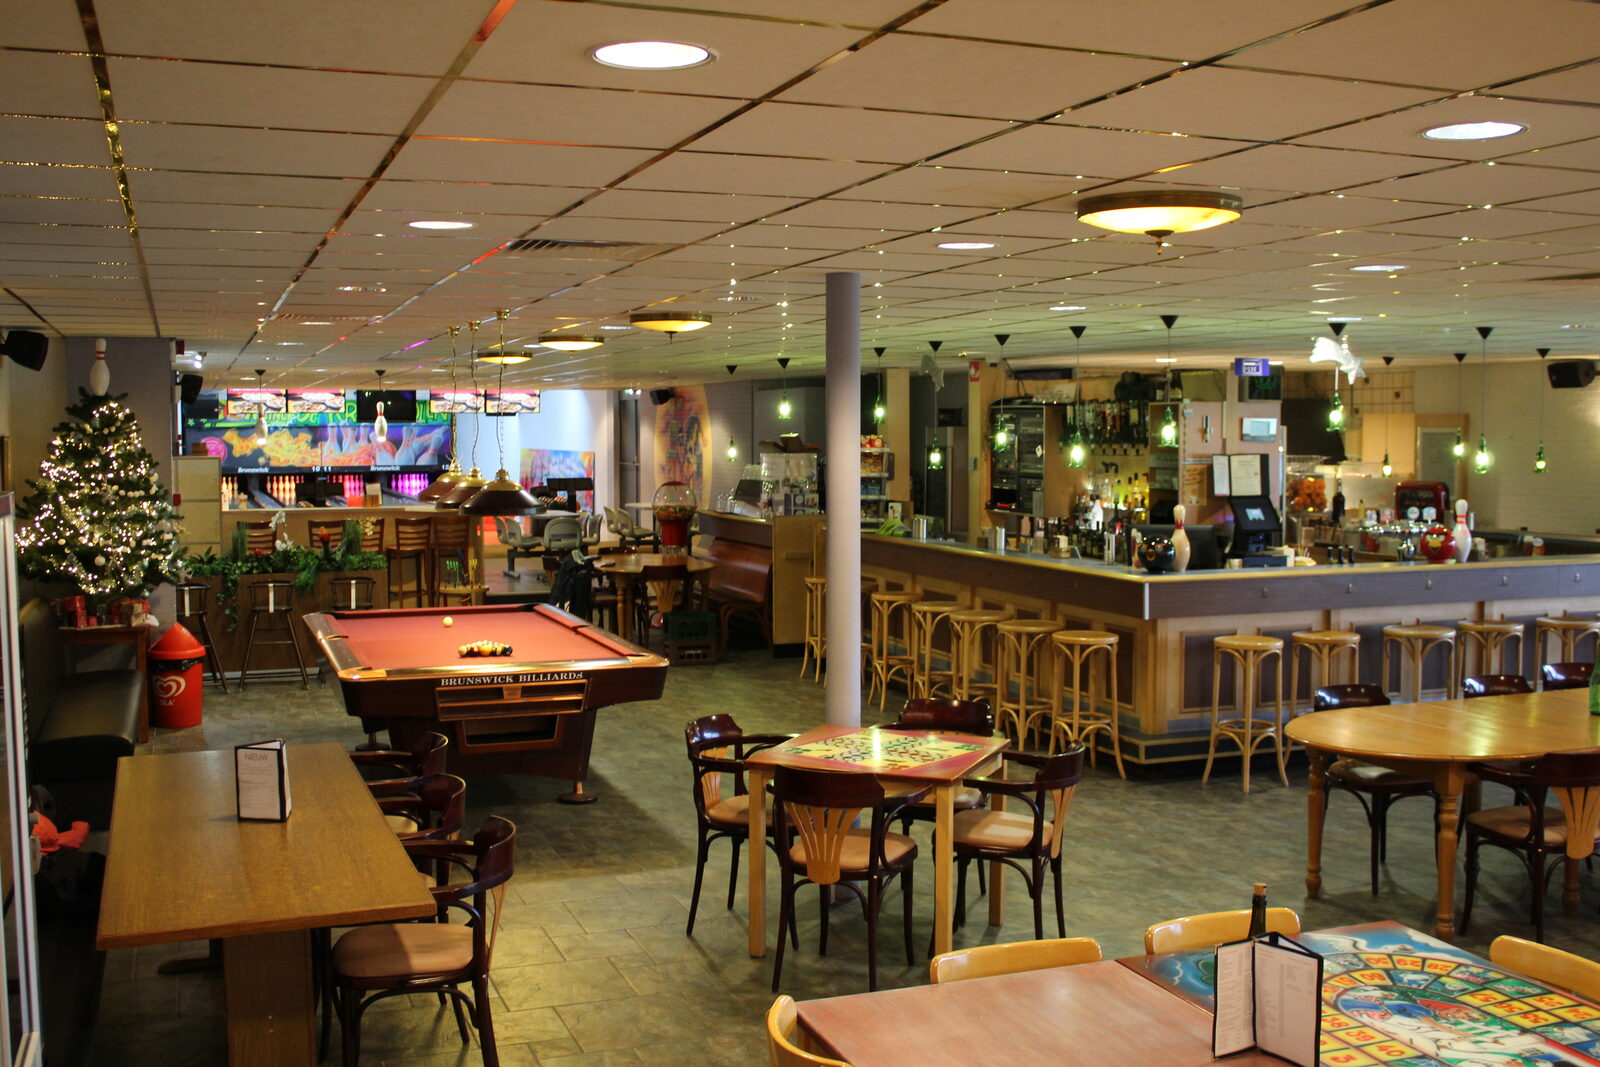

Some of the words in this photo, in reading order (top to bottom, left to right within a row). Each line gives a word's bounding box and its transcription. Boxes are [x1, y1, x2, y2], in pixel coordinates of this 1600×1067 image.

[440, 674, 514, 687] BRUNSWICK
[518, 671, 584, 683] BILLIARDS
[1395, 957, 1422, 968] 29
[1468, 992, 1499, 1004] 57
[1532, 996, 1565, 1007] 25
[1492, 1002, 1525, 1014] 56
[1564, 1007, 1594, 1020] 24
[1519, 1012, 1550, 1025] 55
[1344, 1029, 1377, 1042] 39
[1375, 1044, 1406, 1057] 40
